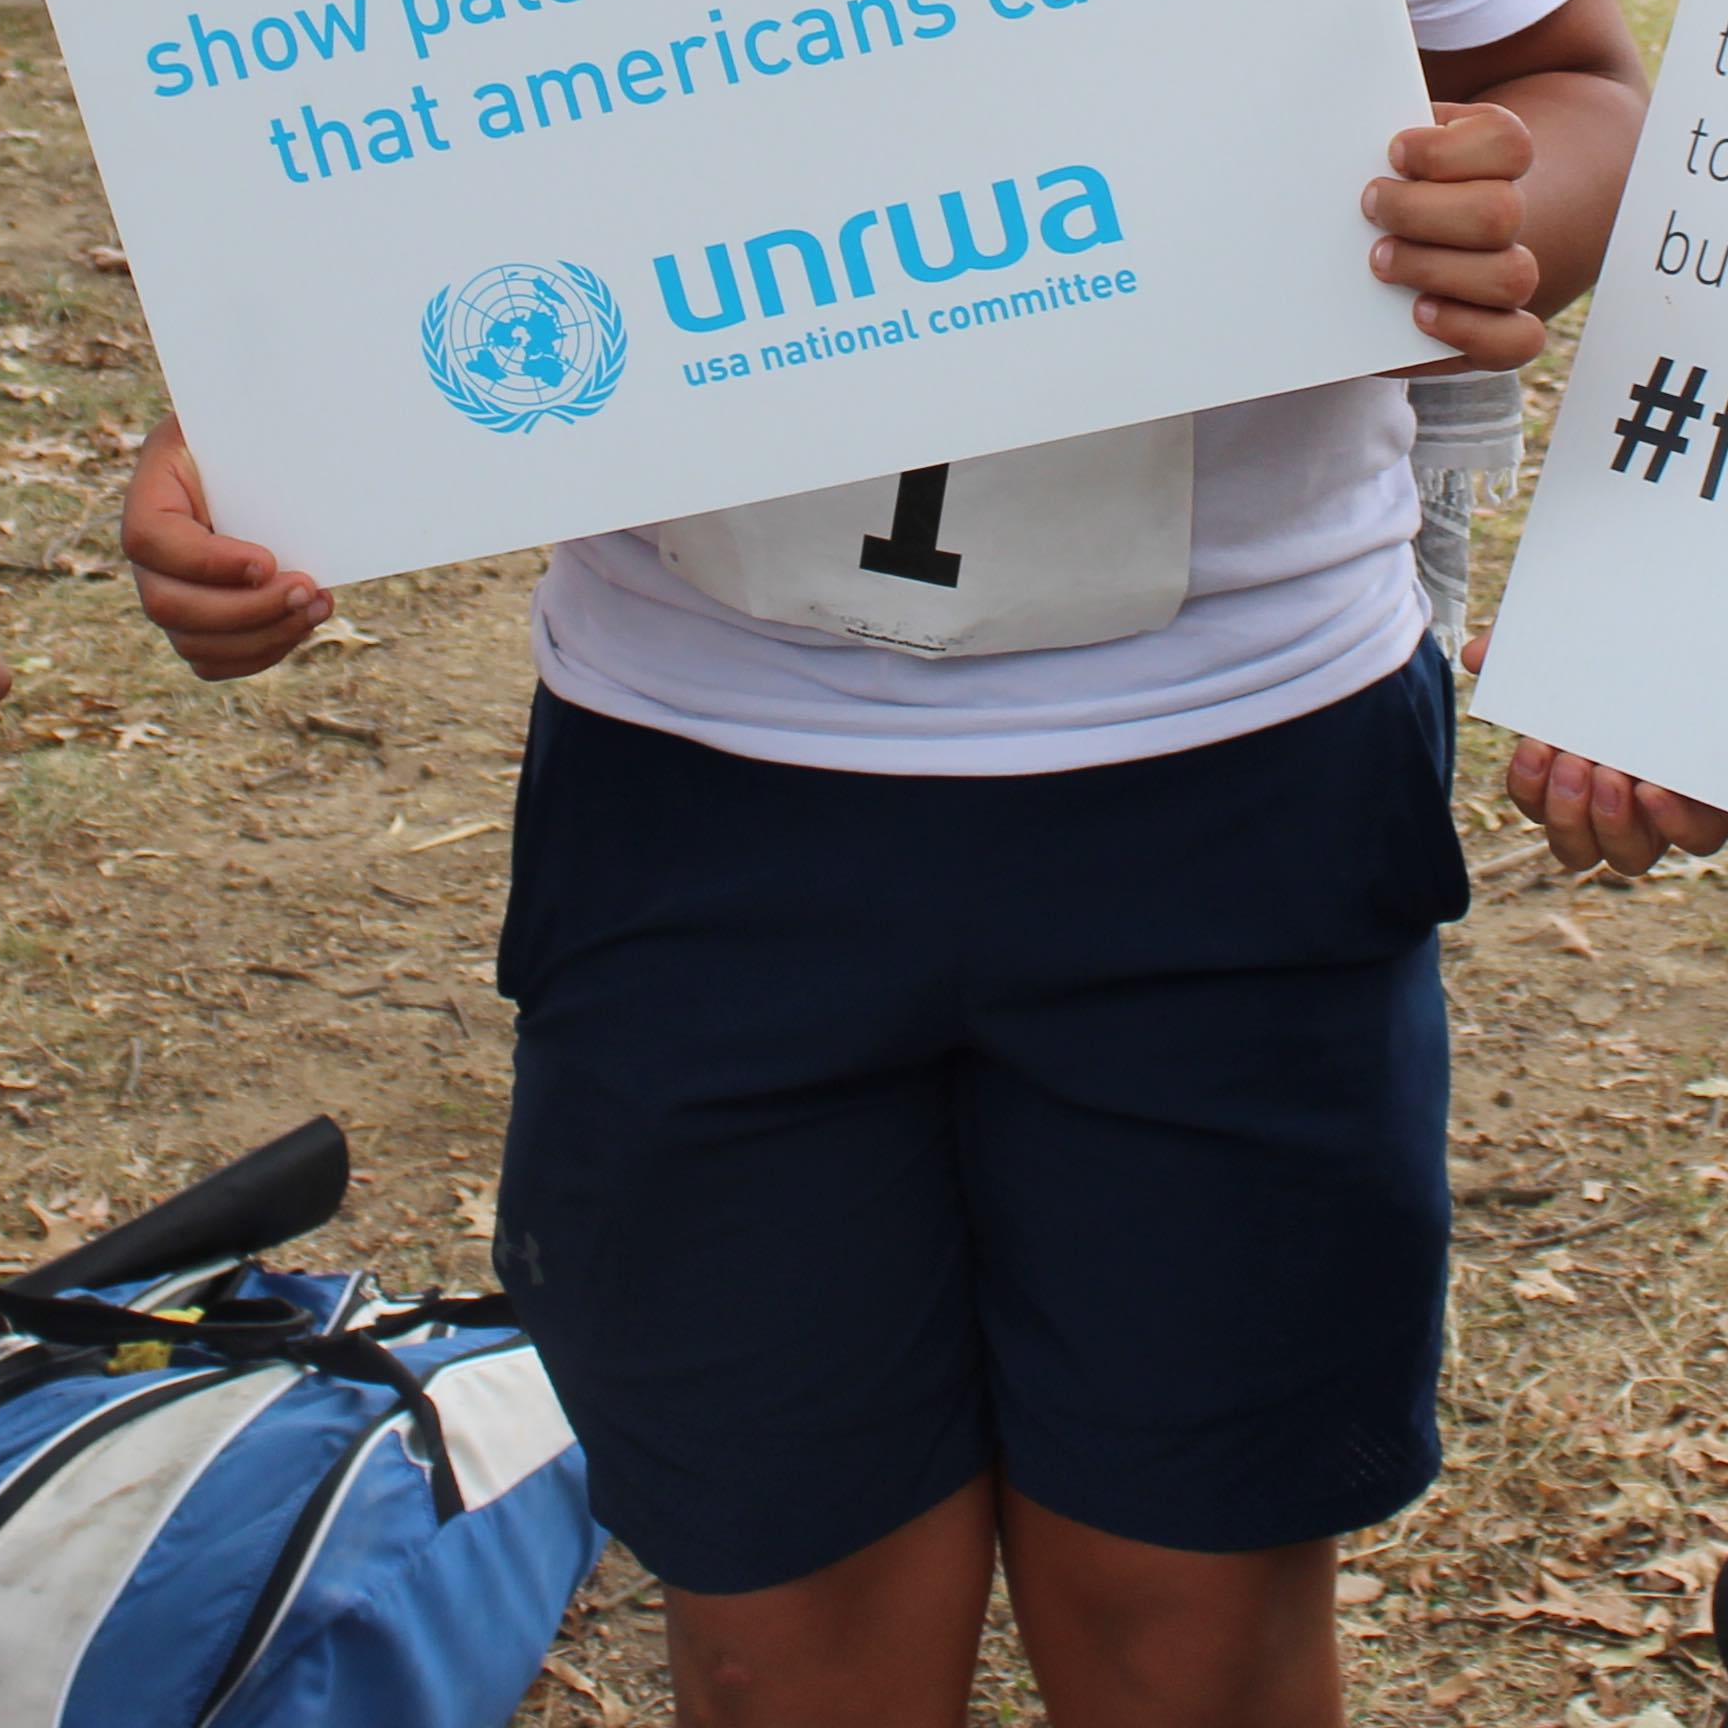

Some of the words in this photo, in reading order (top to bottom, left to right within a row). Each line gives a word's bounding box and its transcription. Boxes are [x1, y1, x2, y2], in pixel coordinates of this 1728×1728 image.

[268, 84, 452, 185] that
[651, 164, 1125, 335] unrwa
[681, 352, 752, 388] usa
[759, 308, 921, 372] national
[927, 268, 1138, 336] committee
